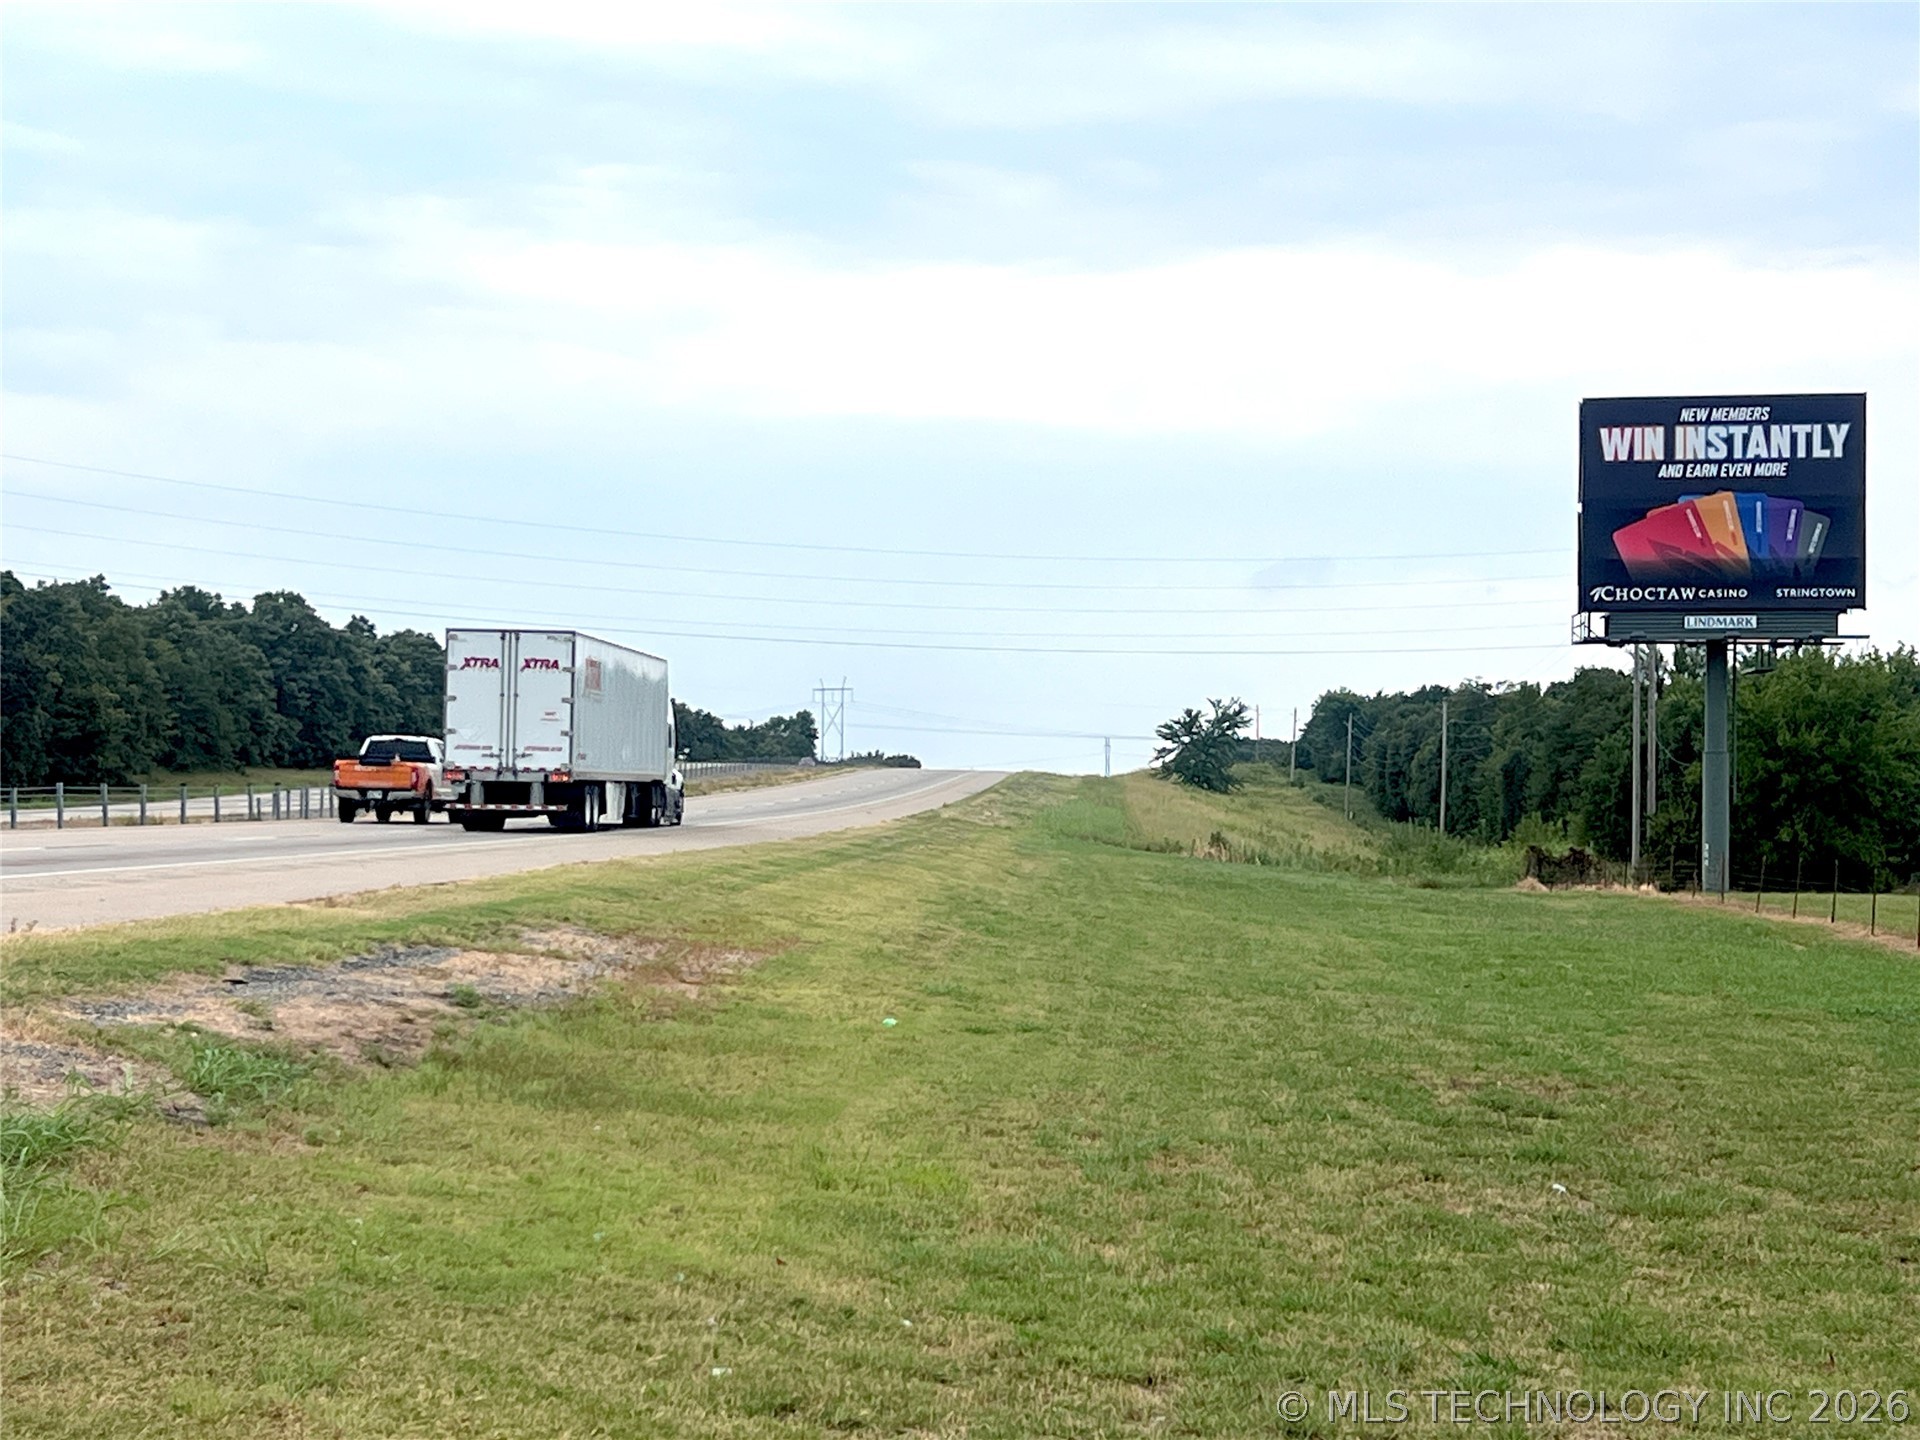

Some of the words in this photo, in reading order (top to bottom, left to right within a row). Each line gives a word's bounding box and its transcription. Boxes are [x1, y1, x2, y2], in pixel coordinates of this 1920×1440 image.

[1680, 408, 1710, 422] NEW
[1711, 406, 1771, 421] MEMBERS
[1599, 426, 1664, 462] WIN
[1675, 423, 1851, 460] INSTANTLY
[1658, 464, 1684, 478] AND
[1685, 463, 1718, 478] EARN
[1720, 463, 1752, 477] EVEN
[1754, 462, 1788, 477] MORE
[1600, 586, 1696, 602] CHOCTAW
[1698, 588, 1748, 598] CASINO
[1776, 588, 1856, 598] STRINGTOWN
[1686, 616, 1754, 628] LINDMARK
[459, 657, 500, 671] XTRA
[520, 658, 560, 672] XTRA
